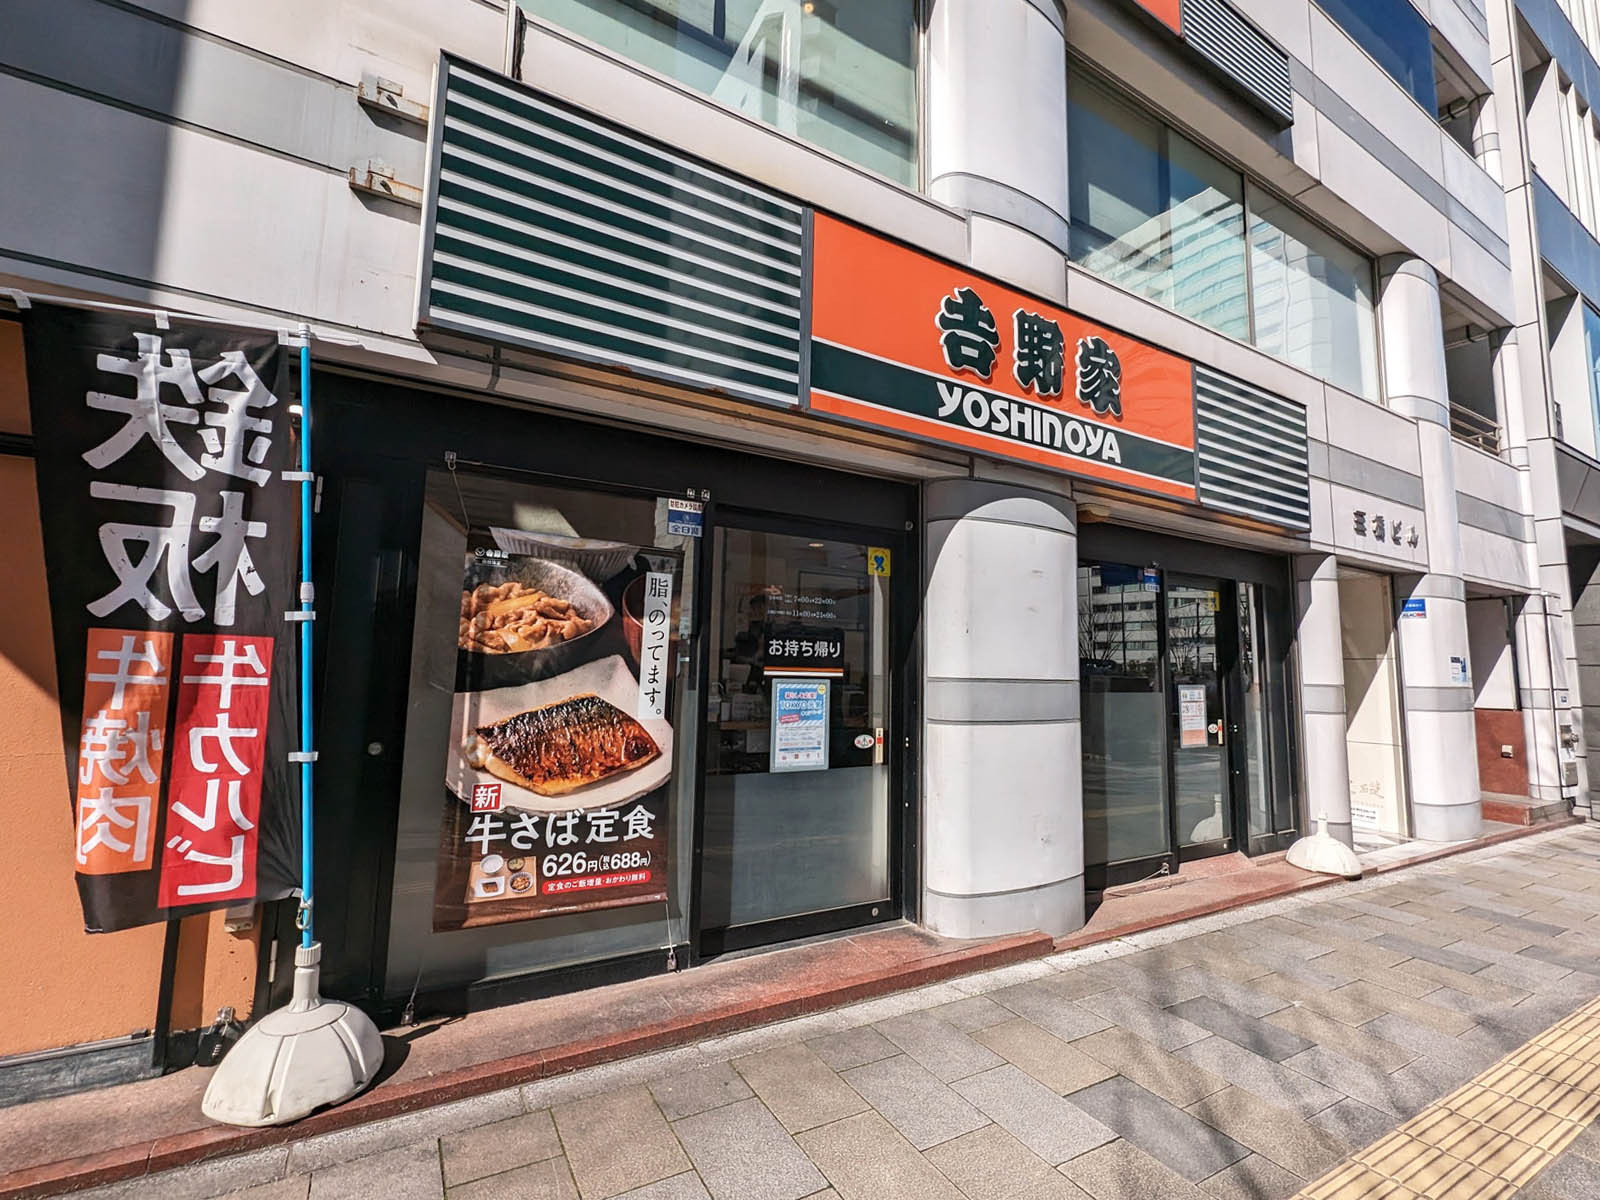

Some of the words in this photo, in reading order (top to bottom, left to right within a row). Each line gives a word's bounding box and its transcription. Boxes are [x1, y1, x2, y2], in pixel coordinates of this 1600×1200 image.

[936, 382, 1122, 464] YOSHINOYA
[644, 577, 668, 715] 脂、のってます。
[768, 639, 841, 658] お持ち帰り
[475, 785, 499, 809] 新
[464, 804, 656, 855] 牛さば定食
